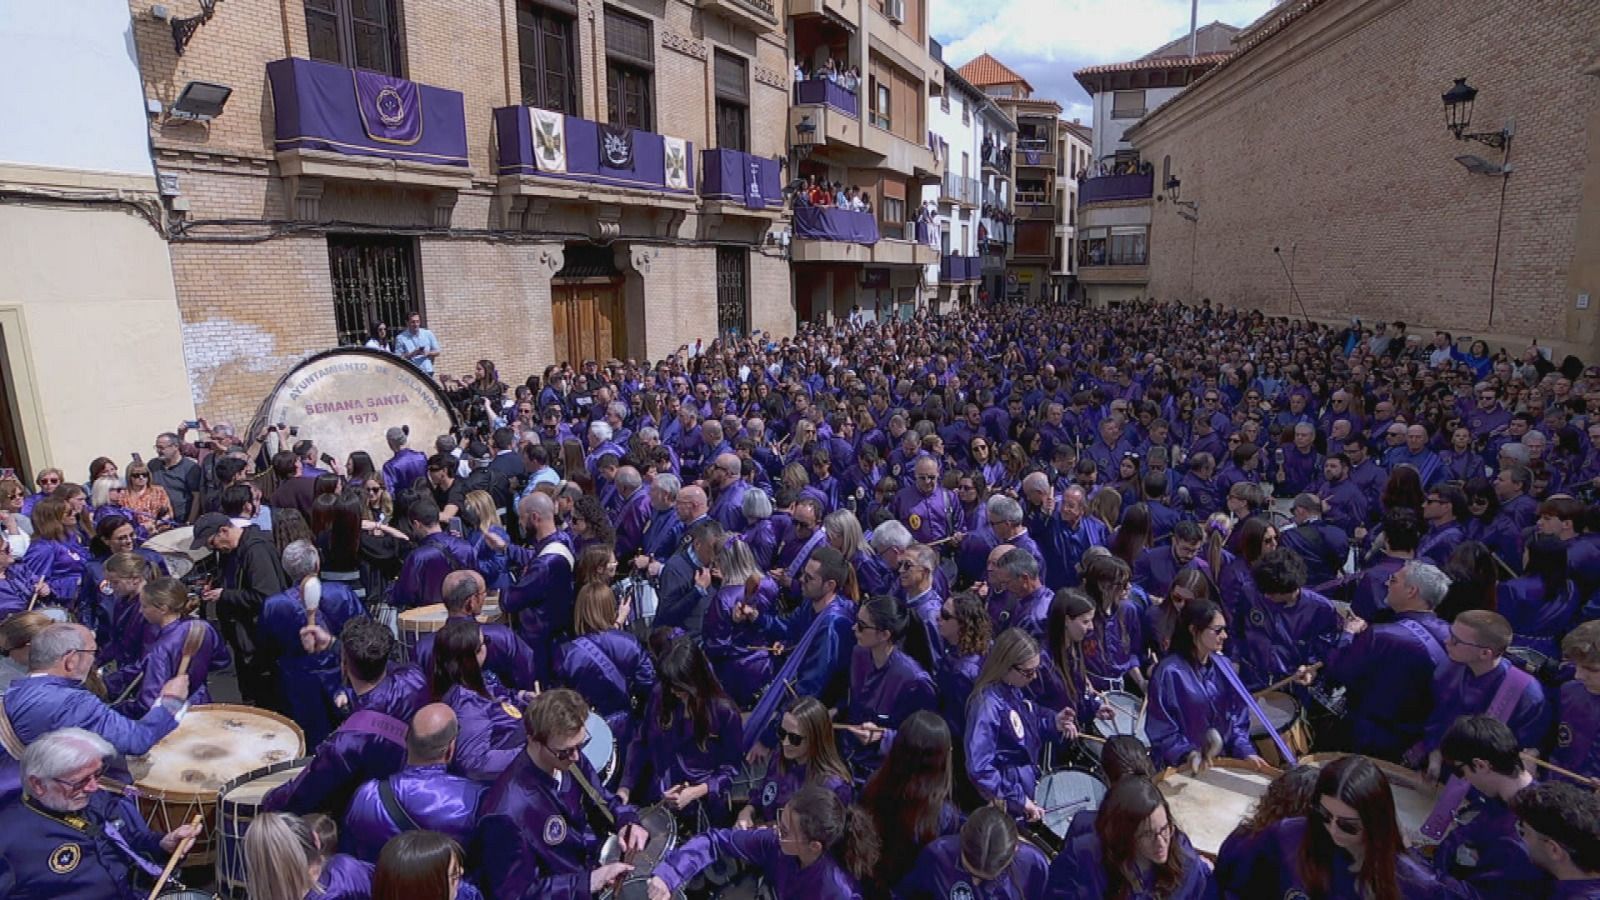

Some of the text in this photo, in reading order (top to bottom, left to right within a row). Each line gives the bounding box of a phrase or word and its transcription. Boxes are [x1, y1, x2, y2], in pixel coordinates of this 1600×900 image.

[289, 362, 440, 415] AYUNTAMIENTO DE CALANDA
[305, 399, 364, 416] SEMANA
[367, 393, 410, 408] SANTA
[347, 412, 379, 425] 1973
